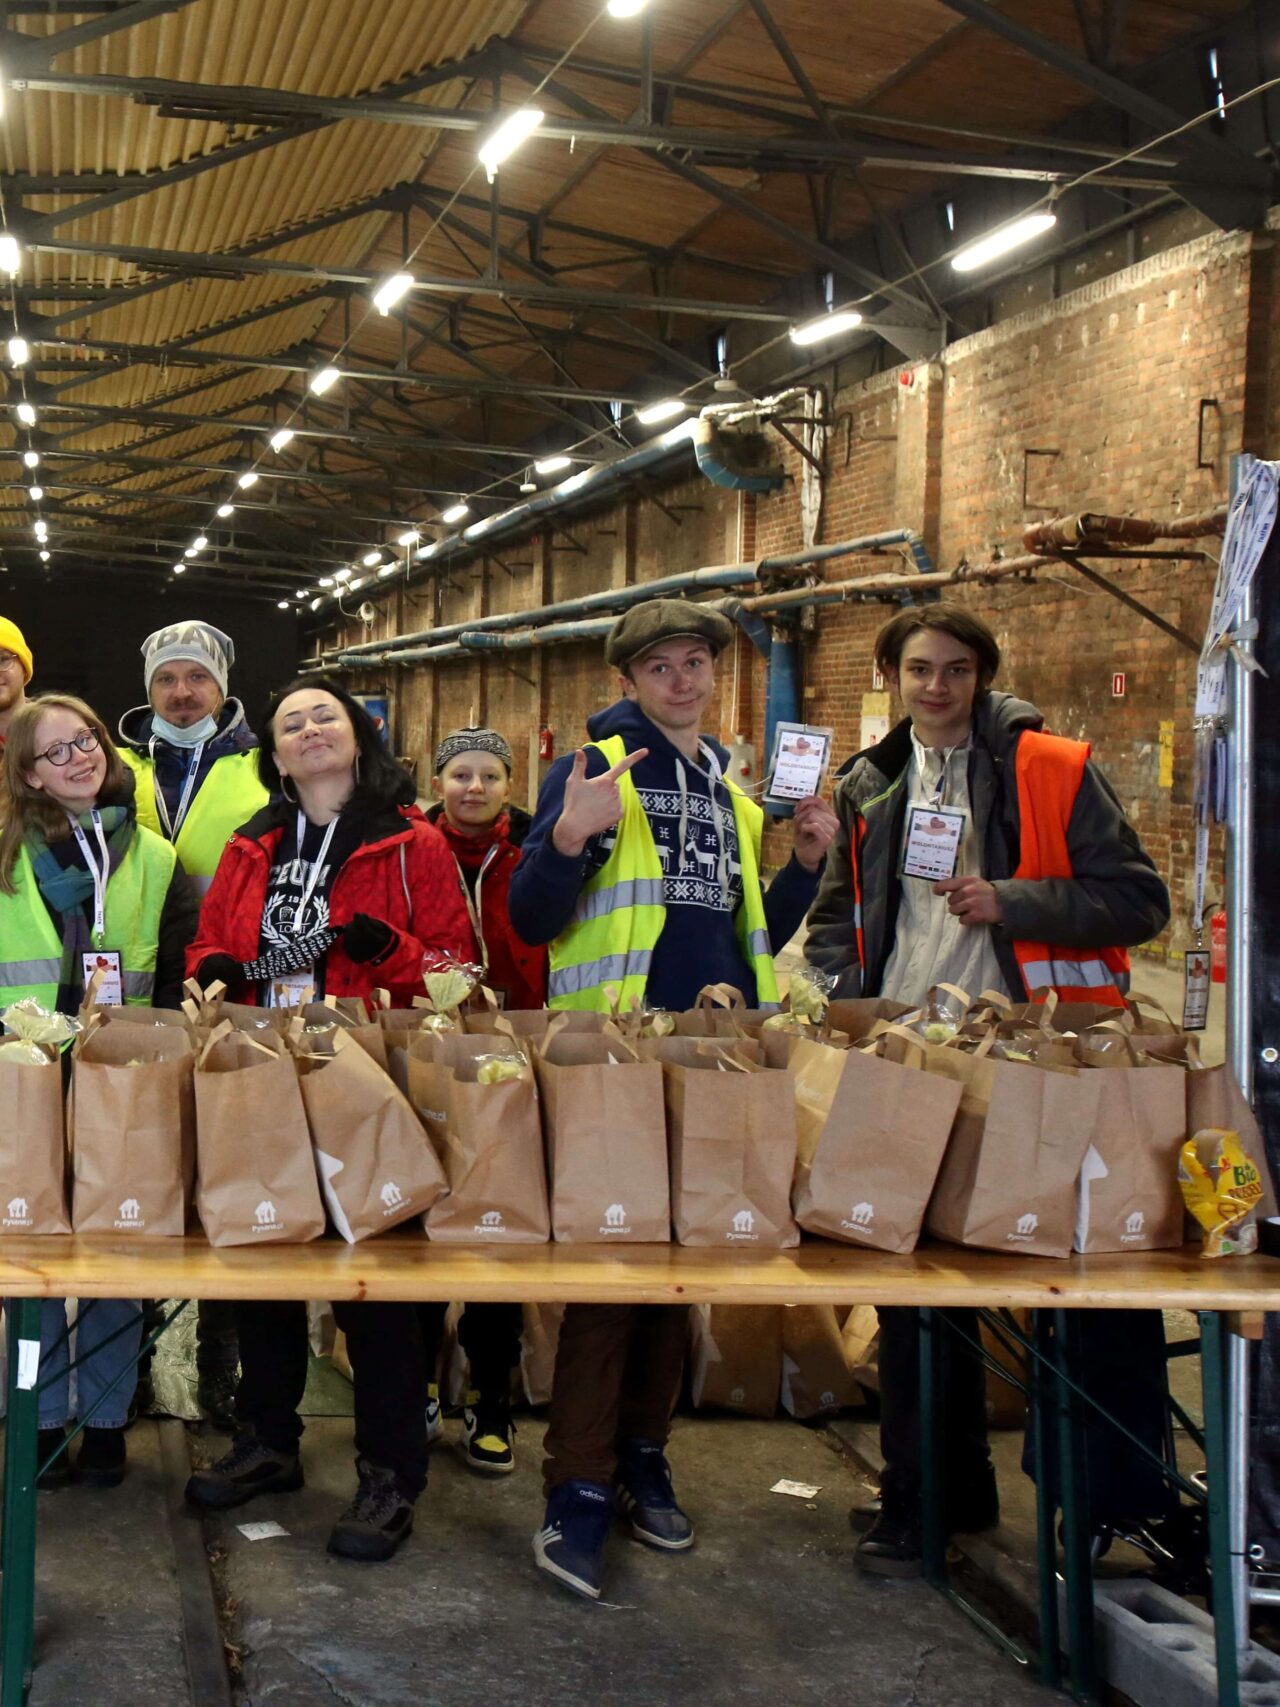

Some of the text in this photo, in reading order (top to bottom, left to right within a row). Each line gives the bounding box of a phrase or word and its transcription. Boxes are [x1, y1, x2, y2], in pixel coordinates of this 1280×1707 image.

[2, 1218, 33, 1227] Pyszne.pl
[114, 1219, 145, 1228] Pyszne.pl
[251, 1223, 283, 1233] Pyszne.pl
[474, 1224, 506, 1234] Pyszne.pl
[599, 1226, 631, 1235] Pyszne.pl
[579, 1490, 605, 1502] adidas
